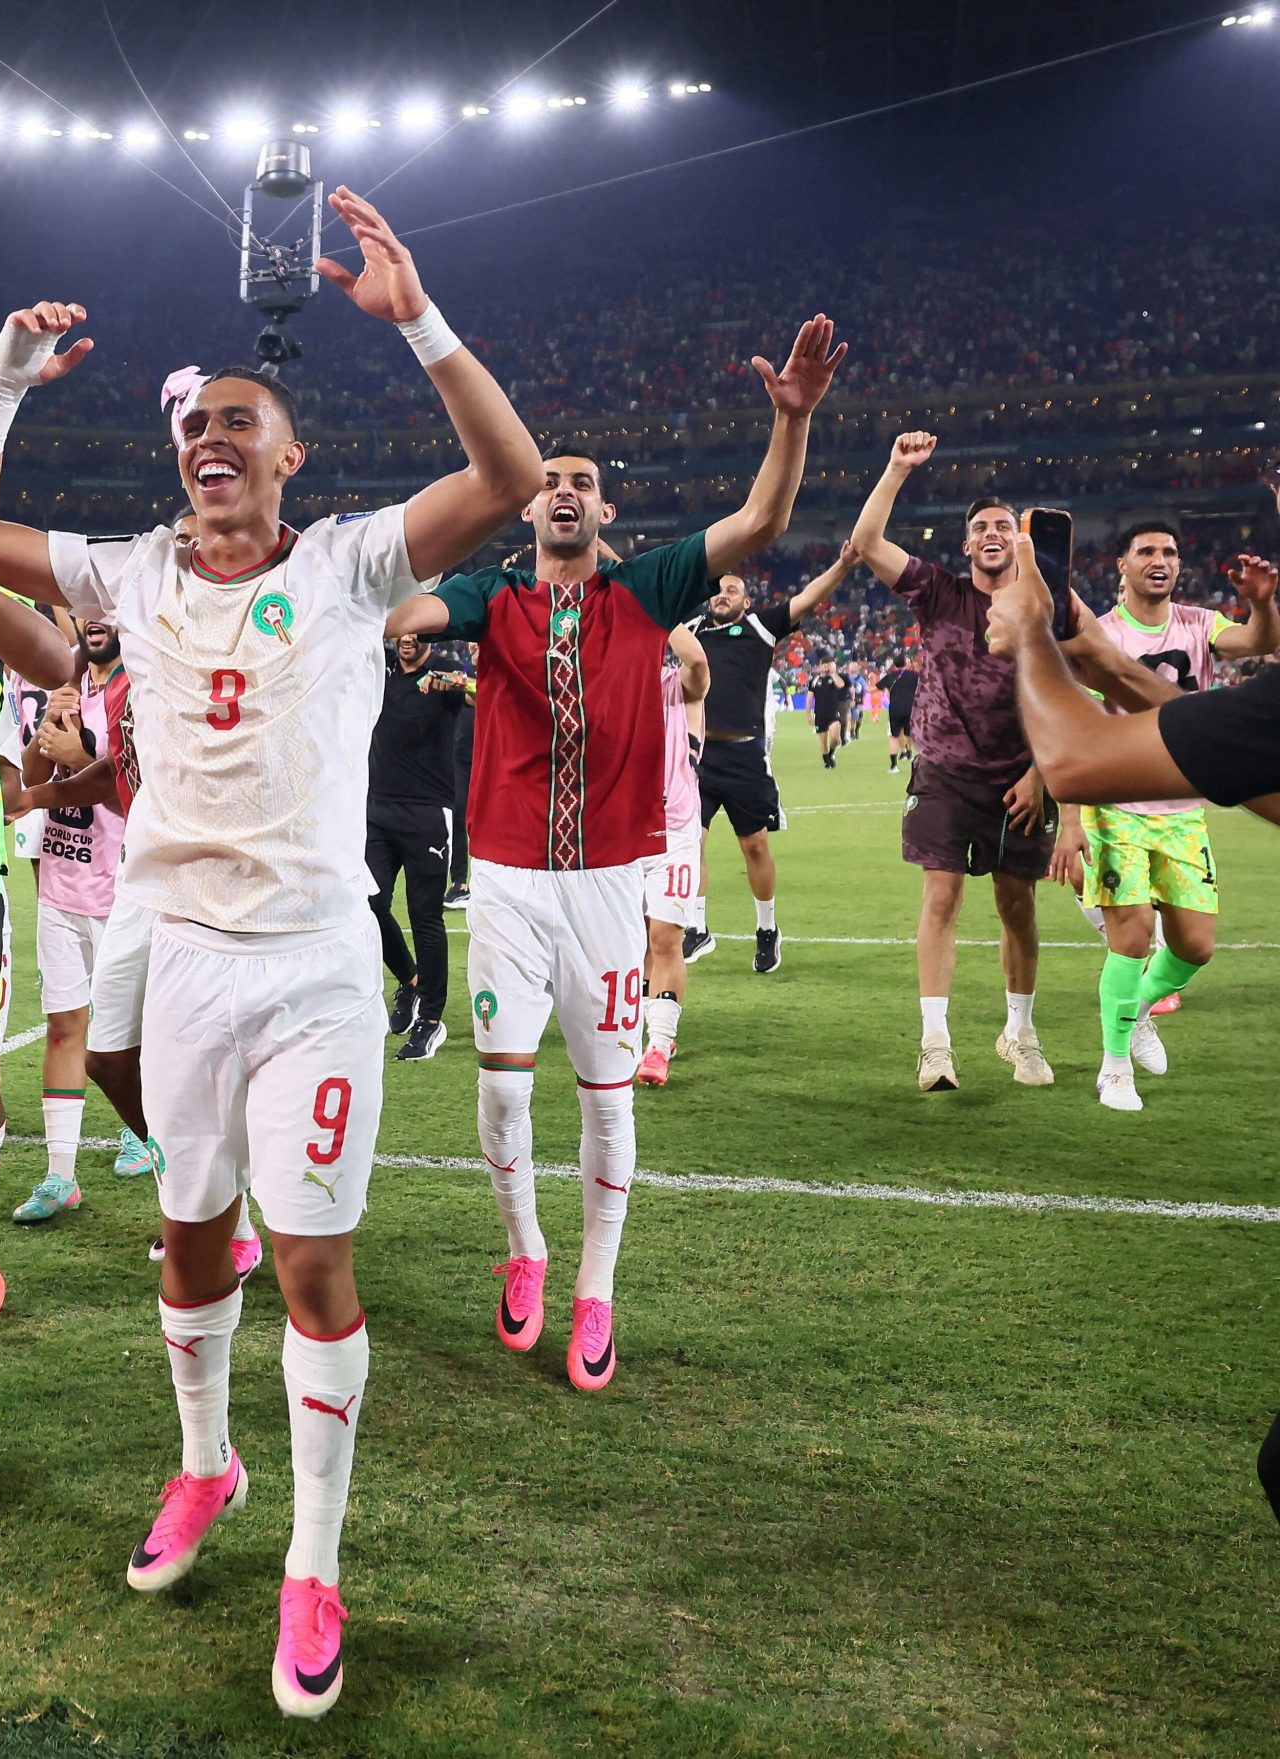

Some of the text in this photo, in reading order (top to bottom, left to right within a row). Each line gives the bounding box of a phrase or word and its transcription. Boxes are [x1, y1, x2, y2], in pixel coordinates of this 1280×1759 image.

[206, 668, 246, 730] 9
[42, 837, 92, 864] 2026
[44, 825, 93, 846] WORLD CUP
[665, 863, 691, 899] 10
[1200, 847, 1215, 885] 1
[598, 967, 641, 1032] 19
[306, 1077, 352, 1165] 9
